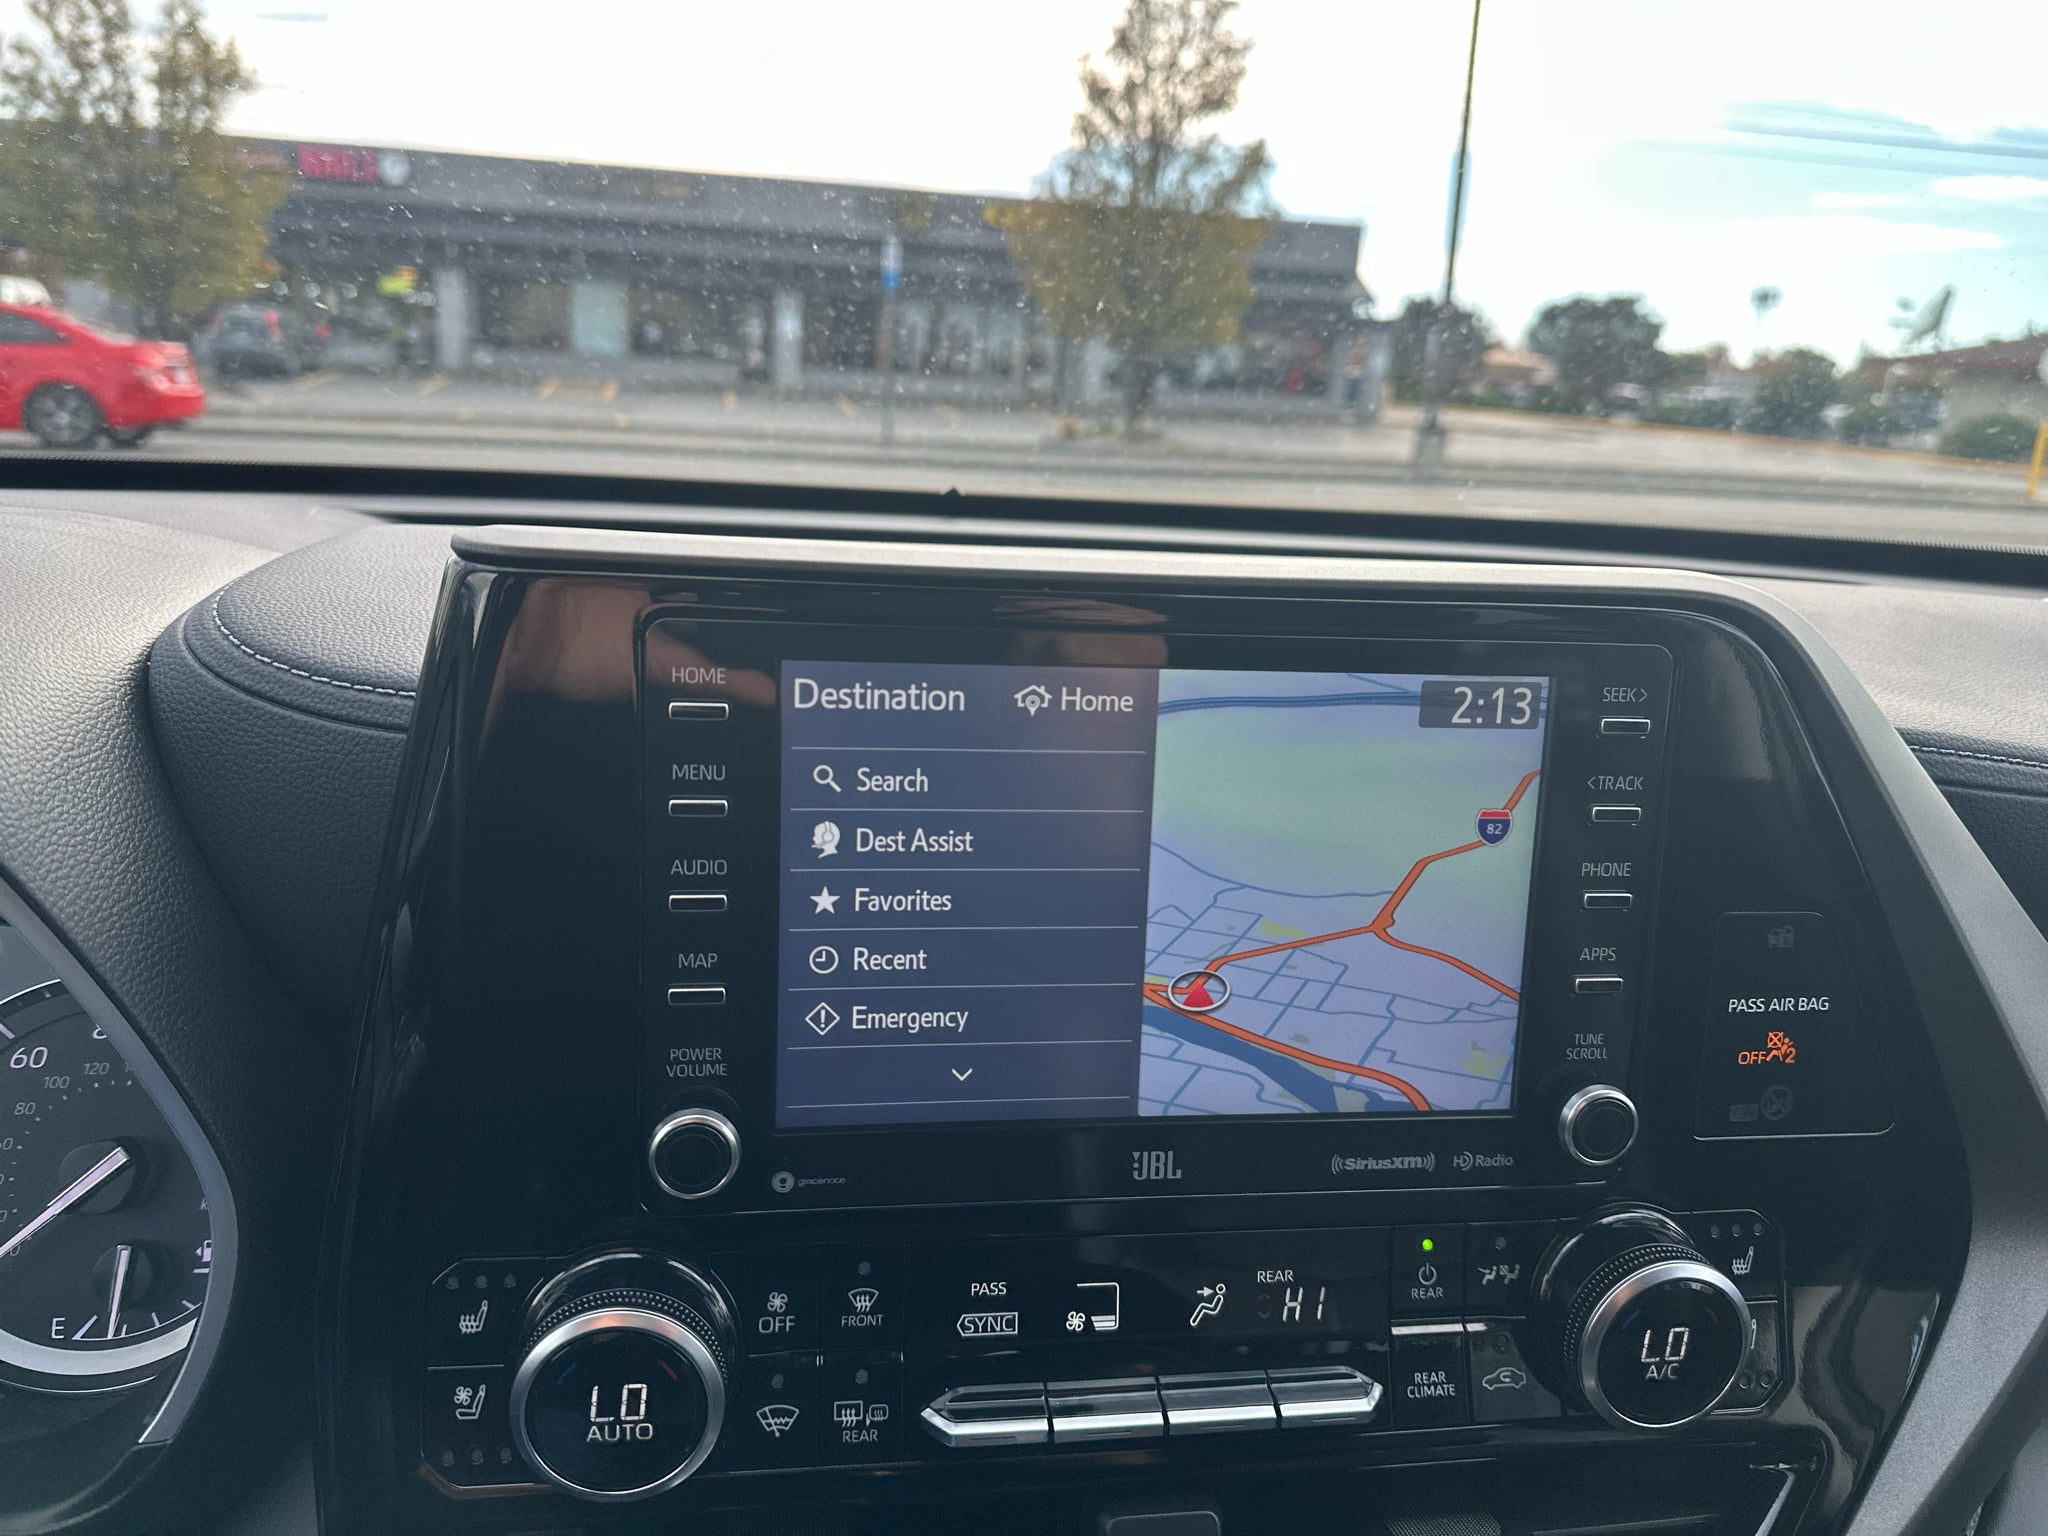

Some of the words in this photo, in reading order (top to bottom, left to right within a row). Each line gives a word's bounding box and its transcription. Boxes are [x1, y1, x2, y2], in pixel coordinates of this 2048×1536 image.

[671, 667, 726, 685] HOME
[793, 678, 966, 713] Destination
[1060, 687, 1134, 713] Home
[1602, 687, 1636, 703] SEEK
[1451, 686, 1533, 725] 2:13
[671, 764, 726, 781] MENU
[856, 767, 929, 794] Search
[1597, 775, 1643, 791] TRACK
[1486, 822, 1503, 835] 82
[856, 828, 906, 854] Dest
[911, 828, 974, 854] Assist
[670, 859, 728, 876] AUDIO
[1581, 862, 1631, 878] PHONE
[854, 887, 952, 914] Favorites
[677, 953, 718, 969] MAP
[853, 947, 927, 972] Recent
[1580, 947, 1617, 963] APPS
[1728, 998, 1765, 1012] PASS
[1768, 998, 1795, 1011] AIR
[1798, 997, 1830, 1011] BAG
[852, 1006, 969, 1033] Emergency
[1574, 1033, 1605, 1046] TUNE
[9, 1046, 49, 1069] 60
[669, 1047, 722, 1062] POWER
[1566, 1047, 1608, 1060] SCROLL
[1737, 1051, 1766, 1064] OFF
[83, 1062, 110, 1075] 120
[666, 1062, 728, 1077] VOLUME
[43, 1075, 70, 1089] 100
[14, 1102, 36, 1115] 80
[0, 1137, 14, 1151] 0
[1132, 1150, 1182, 1180] JBL
[1475, 1153, 1513, 1168] Radio
[1257, 1269, 1294, 1283] REAR
[971, 1282, 1007, 1296] PASS
[1411, 1286, 1444, 1299] REAR
[51, 1317, 65, 1339] E
[758, 1316, 795, 1334] OFF
[841, 1313, 884, 1328] FRONT
[964, 1315, 1014, 1333] SYNC
[1641, 1326, 1690, 1363] LO
[1413, 1371, 1447, 1384] REAR
[1645, 1363, 1680, 1381] A/C
[1406, 1383, 1456, 1399] CLIMATE
[589, 1383, 648, 1422] LO
[586, 1423, 654, 1442] AUTO
[842, 1430, 878, 1444] REAR
